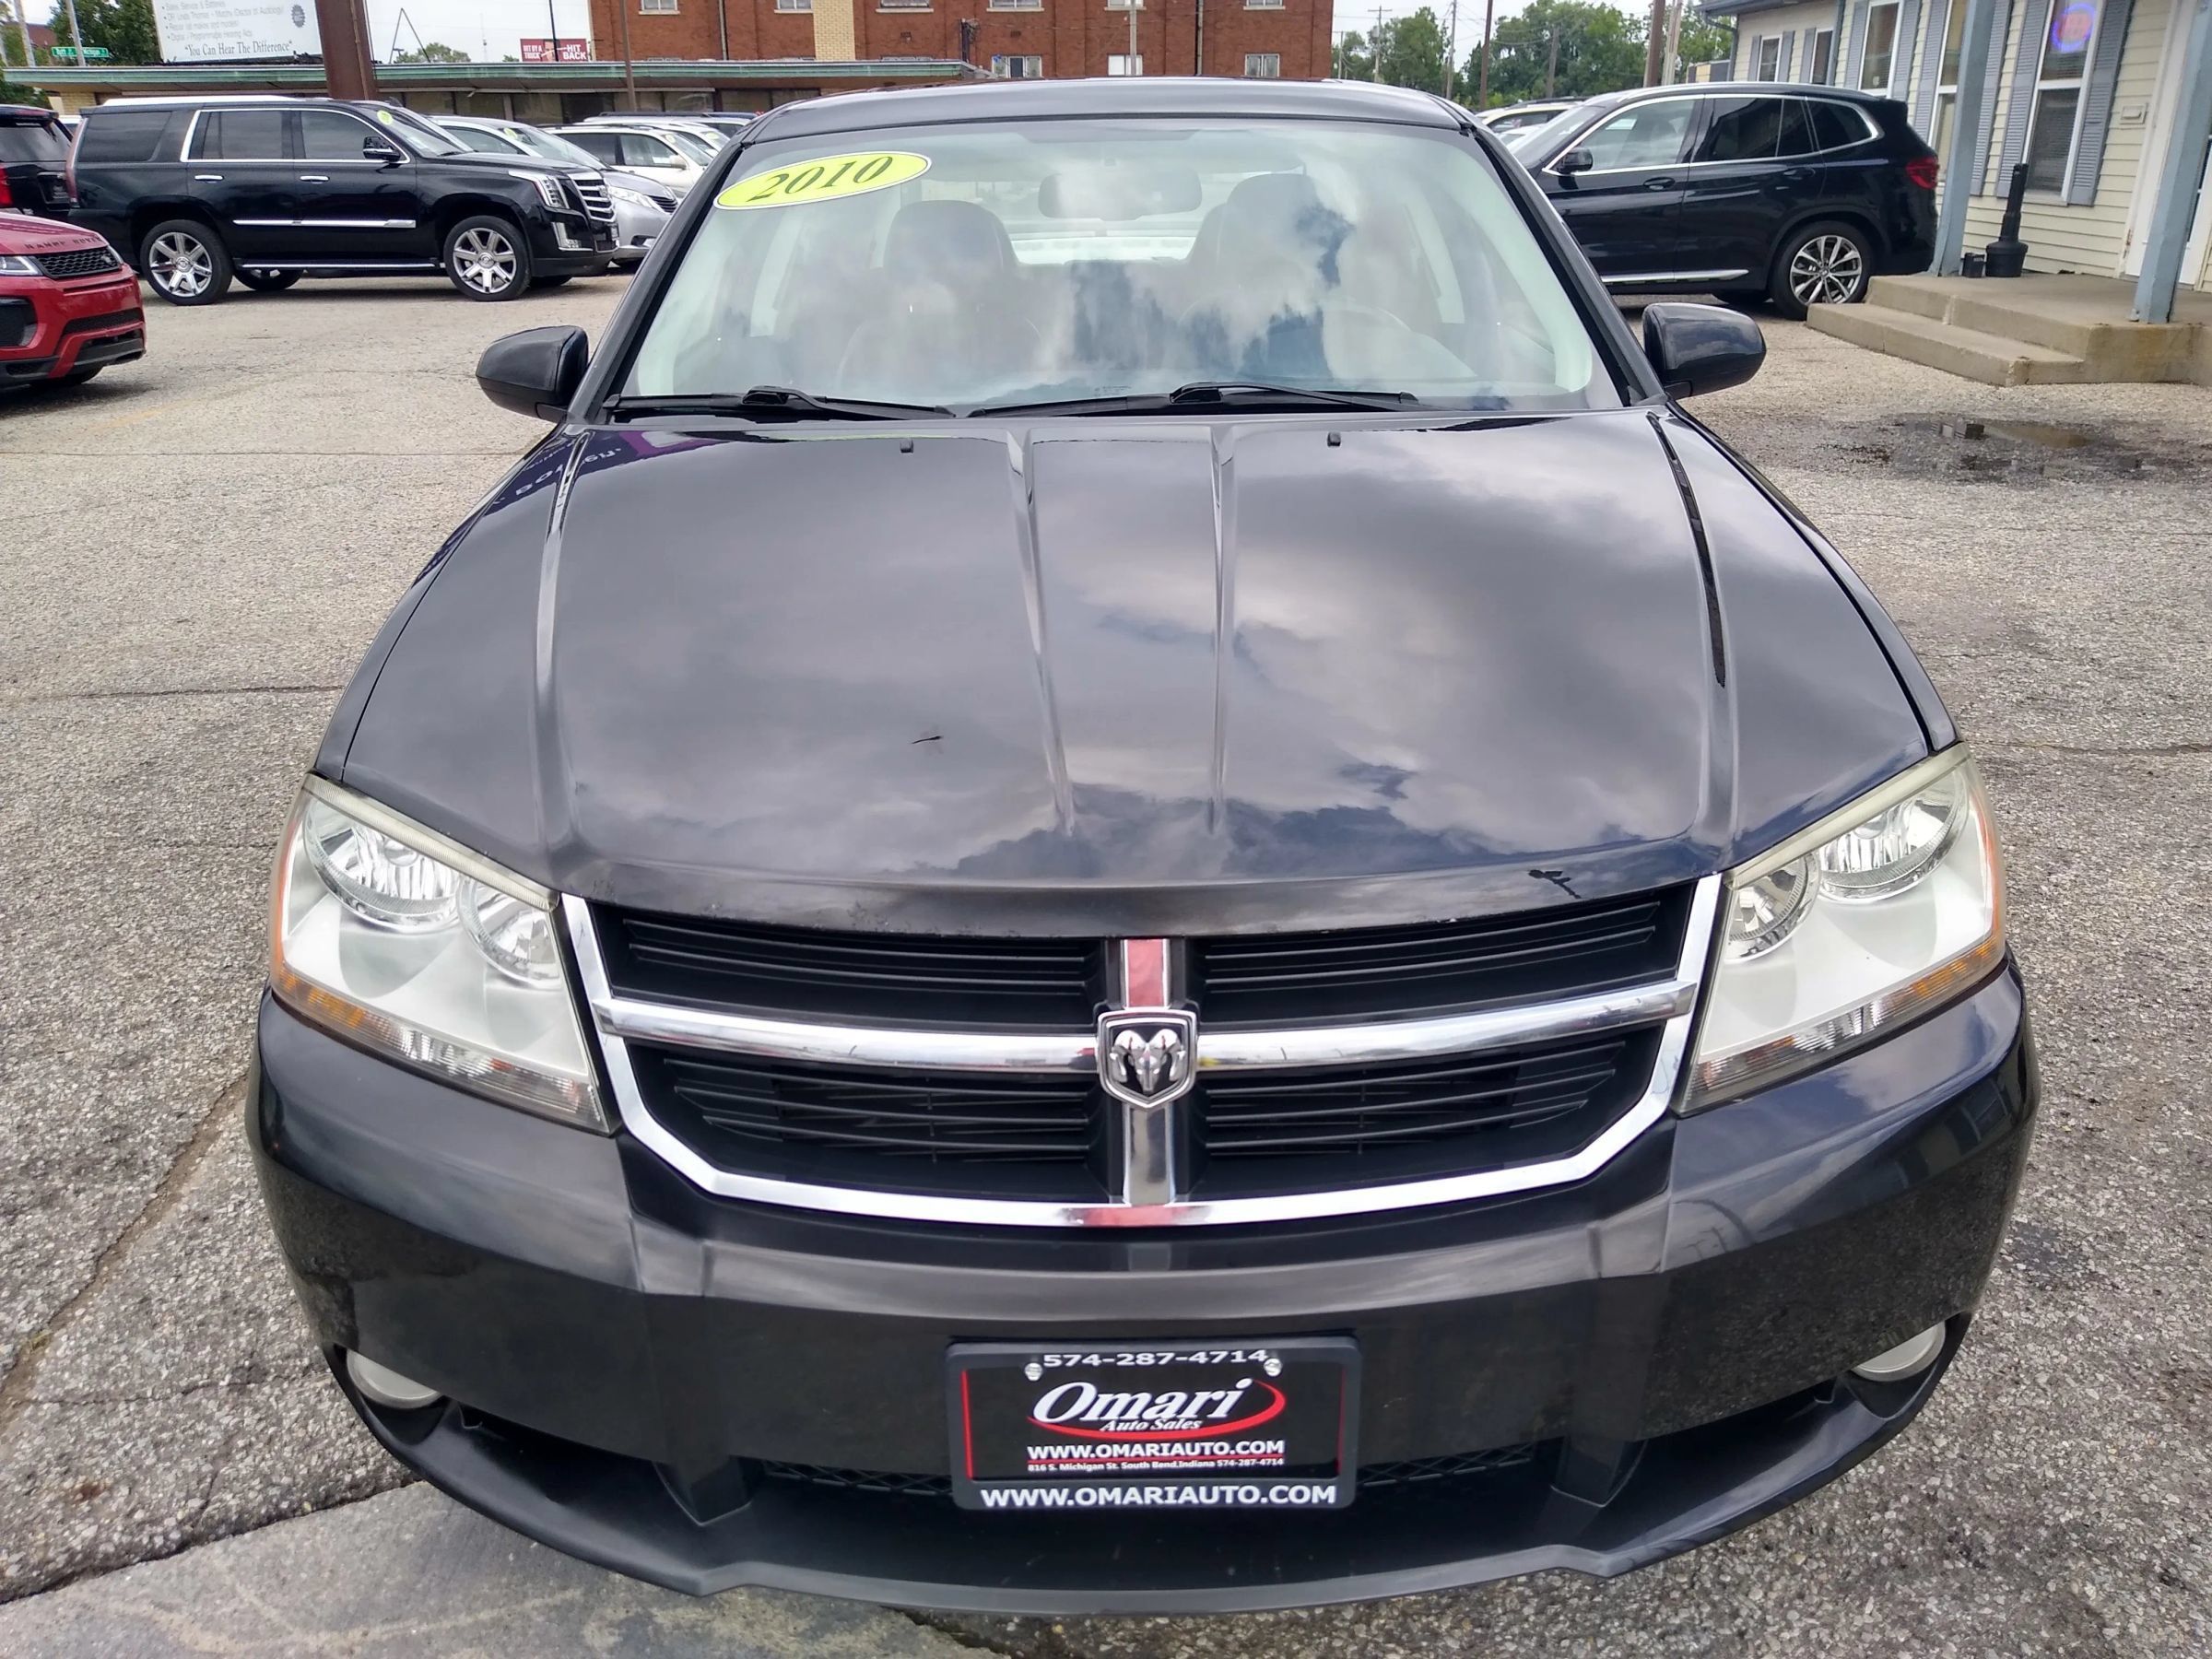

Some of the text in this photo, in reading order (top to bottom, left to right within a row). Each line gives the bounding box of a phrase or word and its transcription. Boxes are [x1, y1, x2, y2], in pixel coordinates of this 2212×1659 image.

[202, 43, 217, 55] Can
[218, 42, 235, 54] Hear
[236, 41, 251, 53] The
[746, 156, 894, 203] 2010
[1042, 1349, 1269, 1368] 574-287-4714
[1033, 1378, 1253, 1424] Omari
[1099, 1418, 1204, 1432] Auto Sales
[1027, 1440, 1285, 1460] WWW.OMARIAUTO.COM
[1028, 1464, 1046, 1472] 816
[1049, 1464, 1057, 1472] S.
[1059, 1463, 1104, 1472] Michigan
[1121, 1461, 1149, 1470] South
[1217, 1458, 1284, 1467] 574-287-4714
[981, 1485, 1336, 1507] WWW.OMARIAUTO.COM
